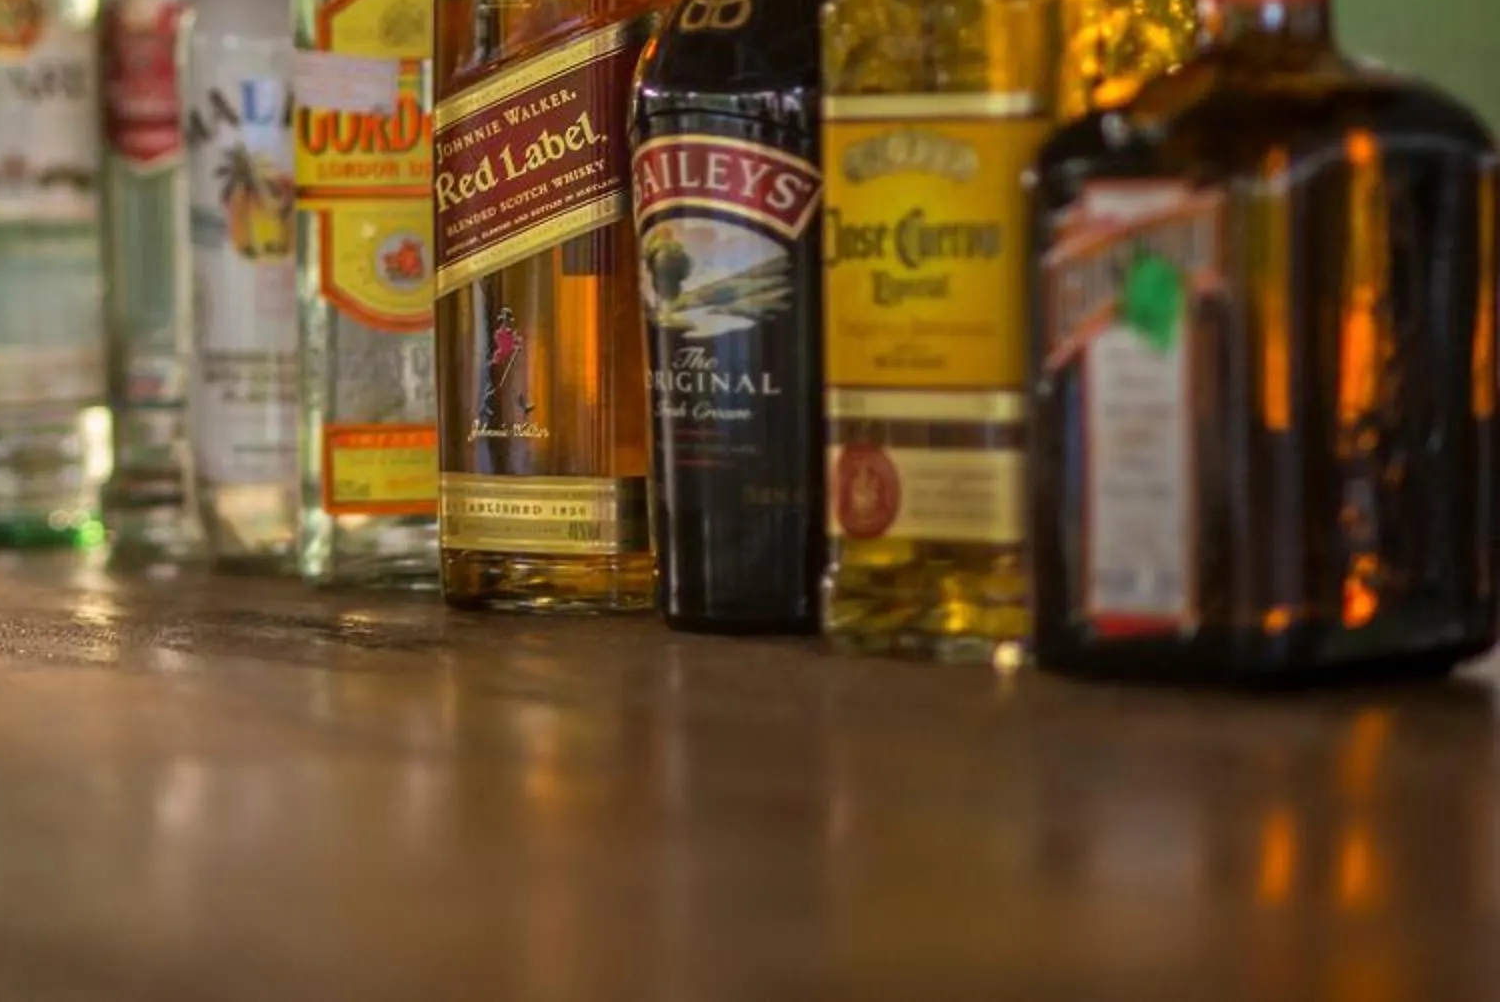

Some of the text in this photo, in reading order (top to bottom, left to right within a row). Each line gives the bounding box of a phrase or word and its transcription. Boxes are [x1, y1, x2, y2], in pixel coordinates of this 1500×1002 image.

[436, 120, 501, 165] JOHNNIE
[435, 154, 499, 214] Red
[500, 182, 549, 212] SCOTCH
[672, 346, 719, 370] The
